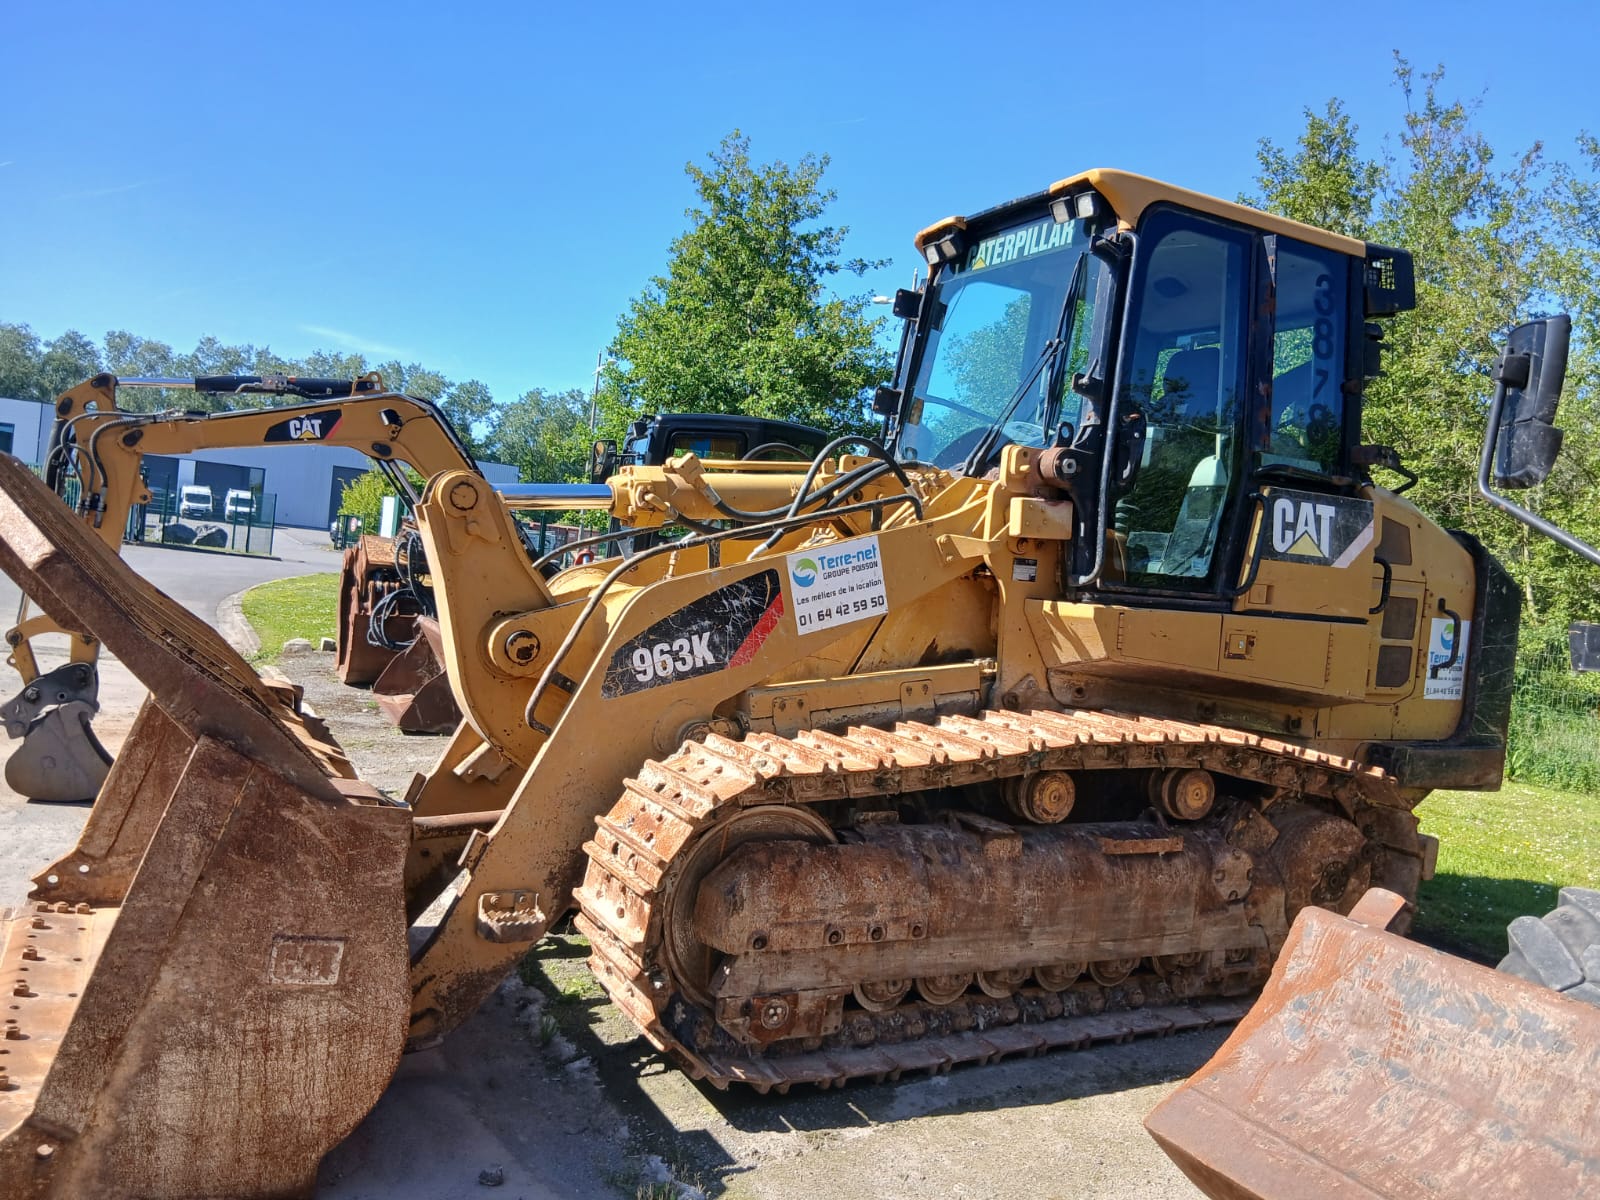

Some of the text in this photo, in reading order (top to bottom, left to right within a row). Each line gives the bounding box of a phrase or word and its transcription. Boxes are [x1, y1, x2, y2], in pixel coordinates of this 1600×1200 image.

[289, 418, 322, 439] CAT
[1272, 498, 1336, 558] CAT
[818, 543, 877, 571] Terre-net
[823, 560, 878, 580] GROUPE POISSON
[796, 597, 809, 606] Les
[838, 587, 847, 595] de
[848, 585, 855, 593] la
[856, 578, 882, 591] location
[799, 595, 885, 626] 01 64 42 59 50
[632, 631, 716, 682] 963K
